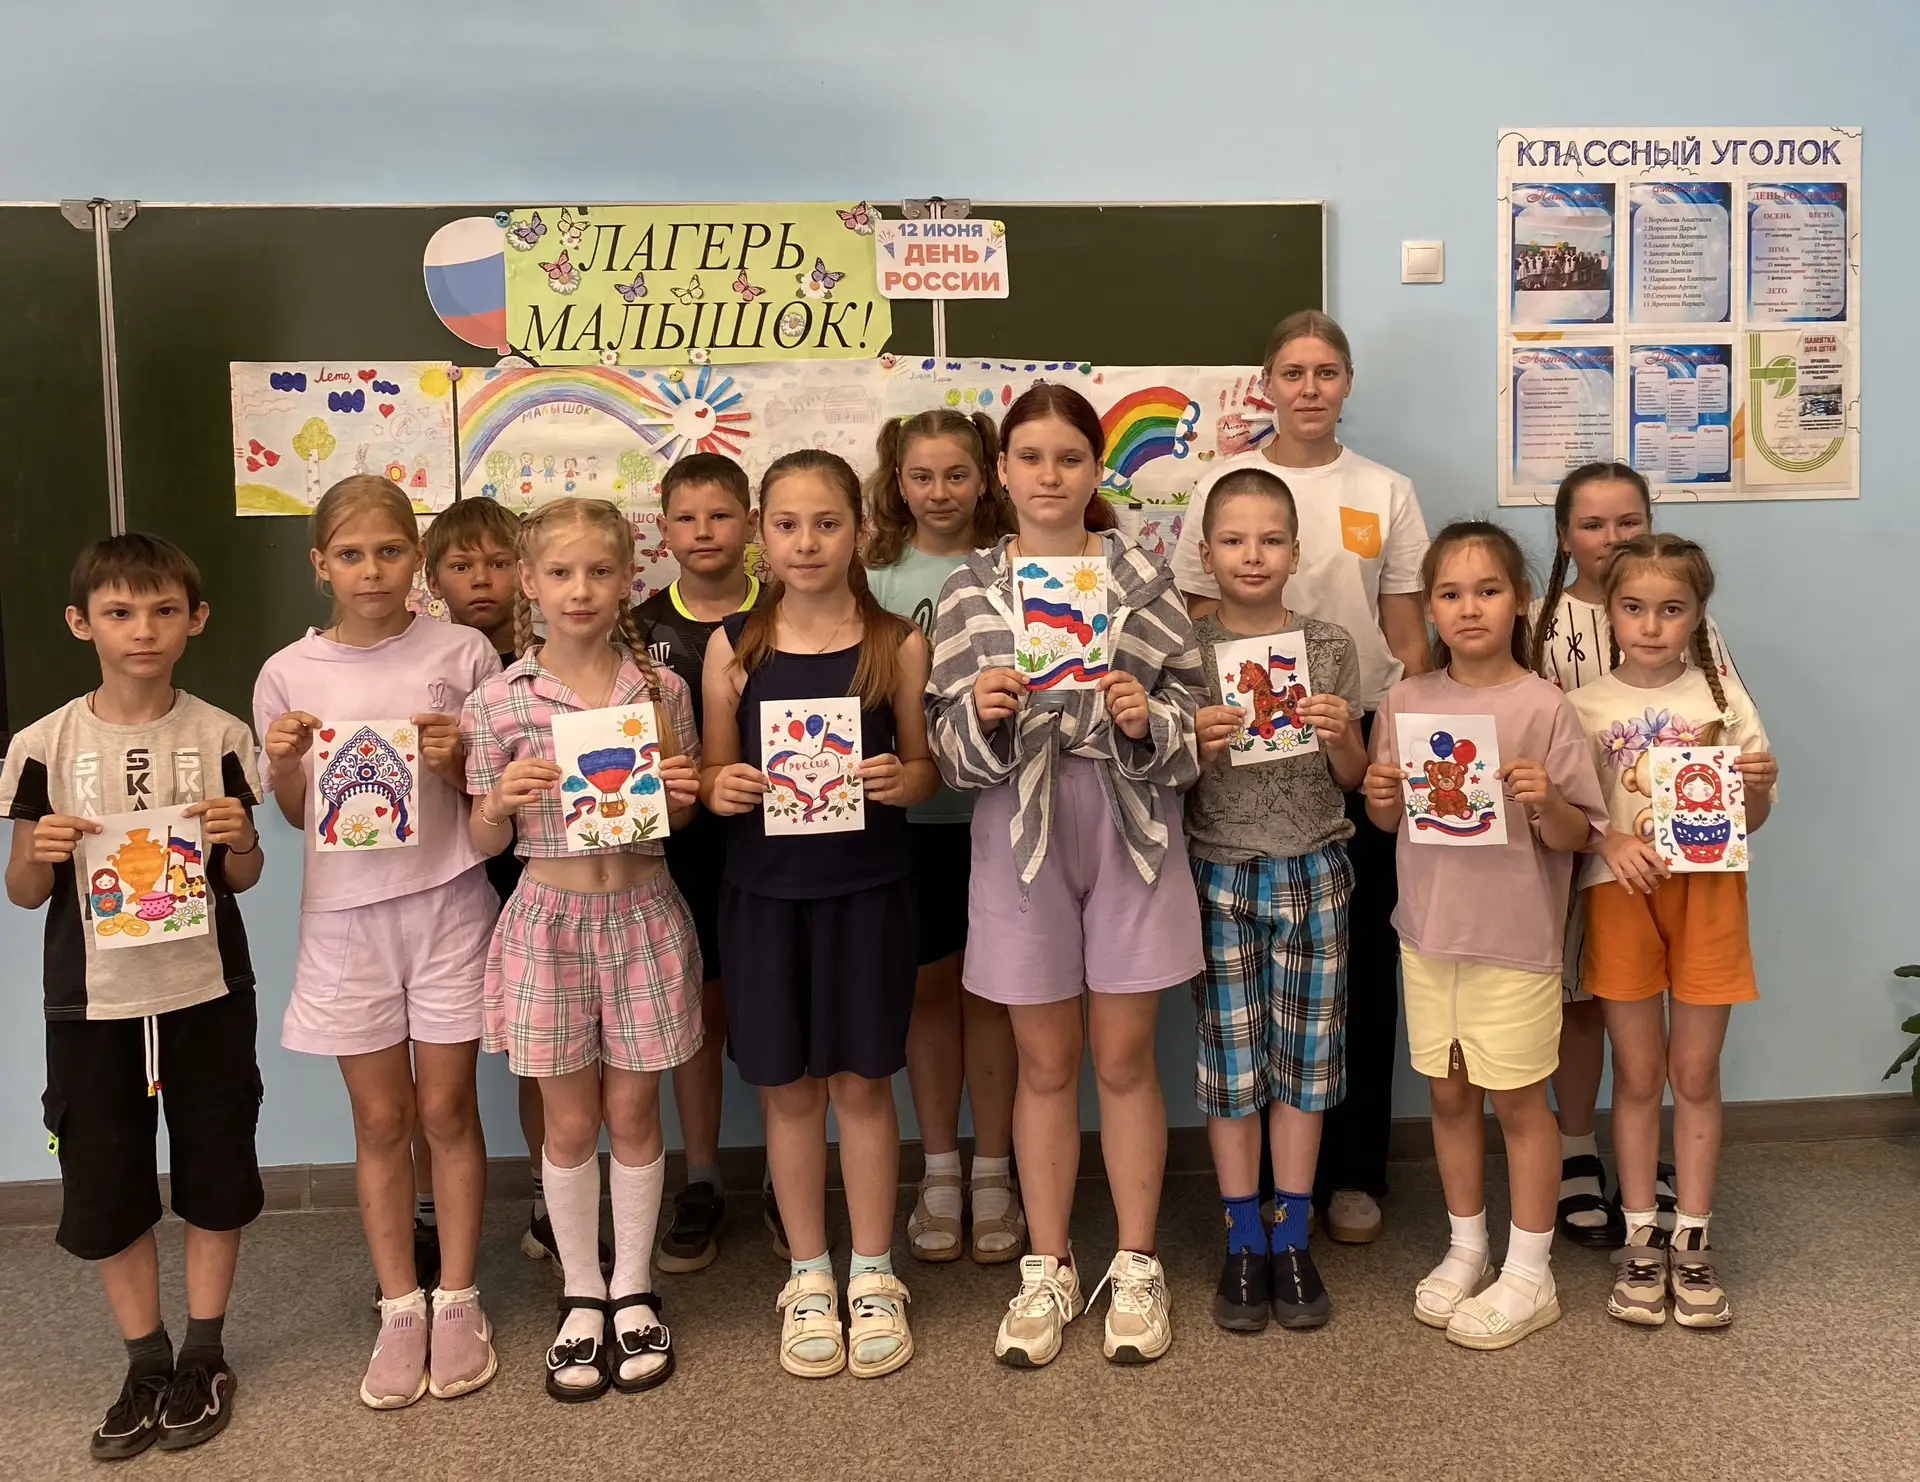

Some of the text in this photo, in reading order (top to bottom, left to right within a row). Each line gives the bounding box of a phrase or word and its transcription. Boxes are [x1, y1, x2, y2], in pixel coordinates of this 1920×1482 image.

[1517, 136, 1842, 166] КЛАССНЫЙ УГОЛОК
[1752, 191, 1781, 201] ДЕНЬ
[1808, 211, 1835, 219] ВЕСНА
[898, 223, 983, 237] 12 ИЮНЯ
[578, 222, 805, 272] ЛАГЕРЬ
[904, 244, 979, 266] ДЕНЬ
[884, 271, 1000, 291] РОССИИ
[521, 301, 873, 351] МАЛЫШОК!
[1804, 336, 1836, 344] ПАМЯТКА
[522, 402, 592, 423] МАЛЫШОК
